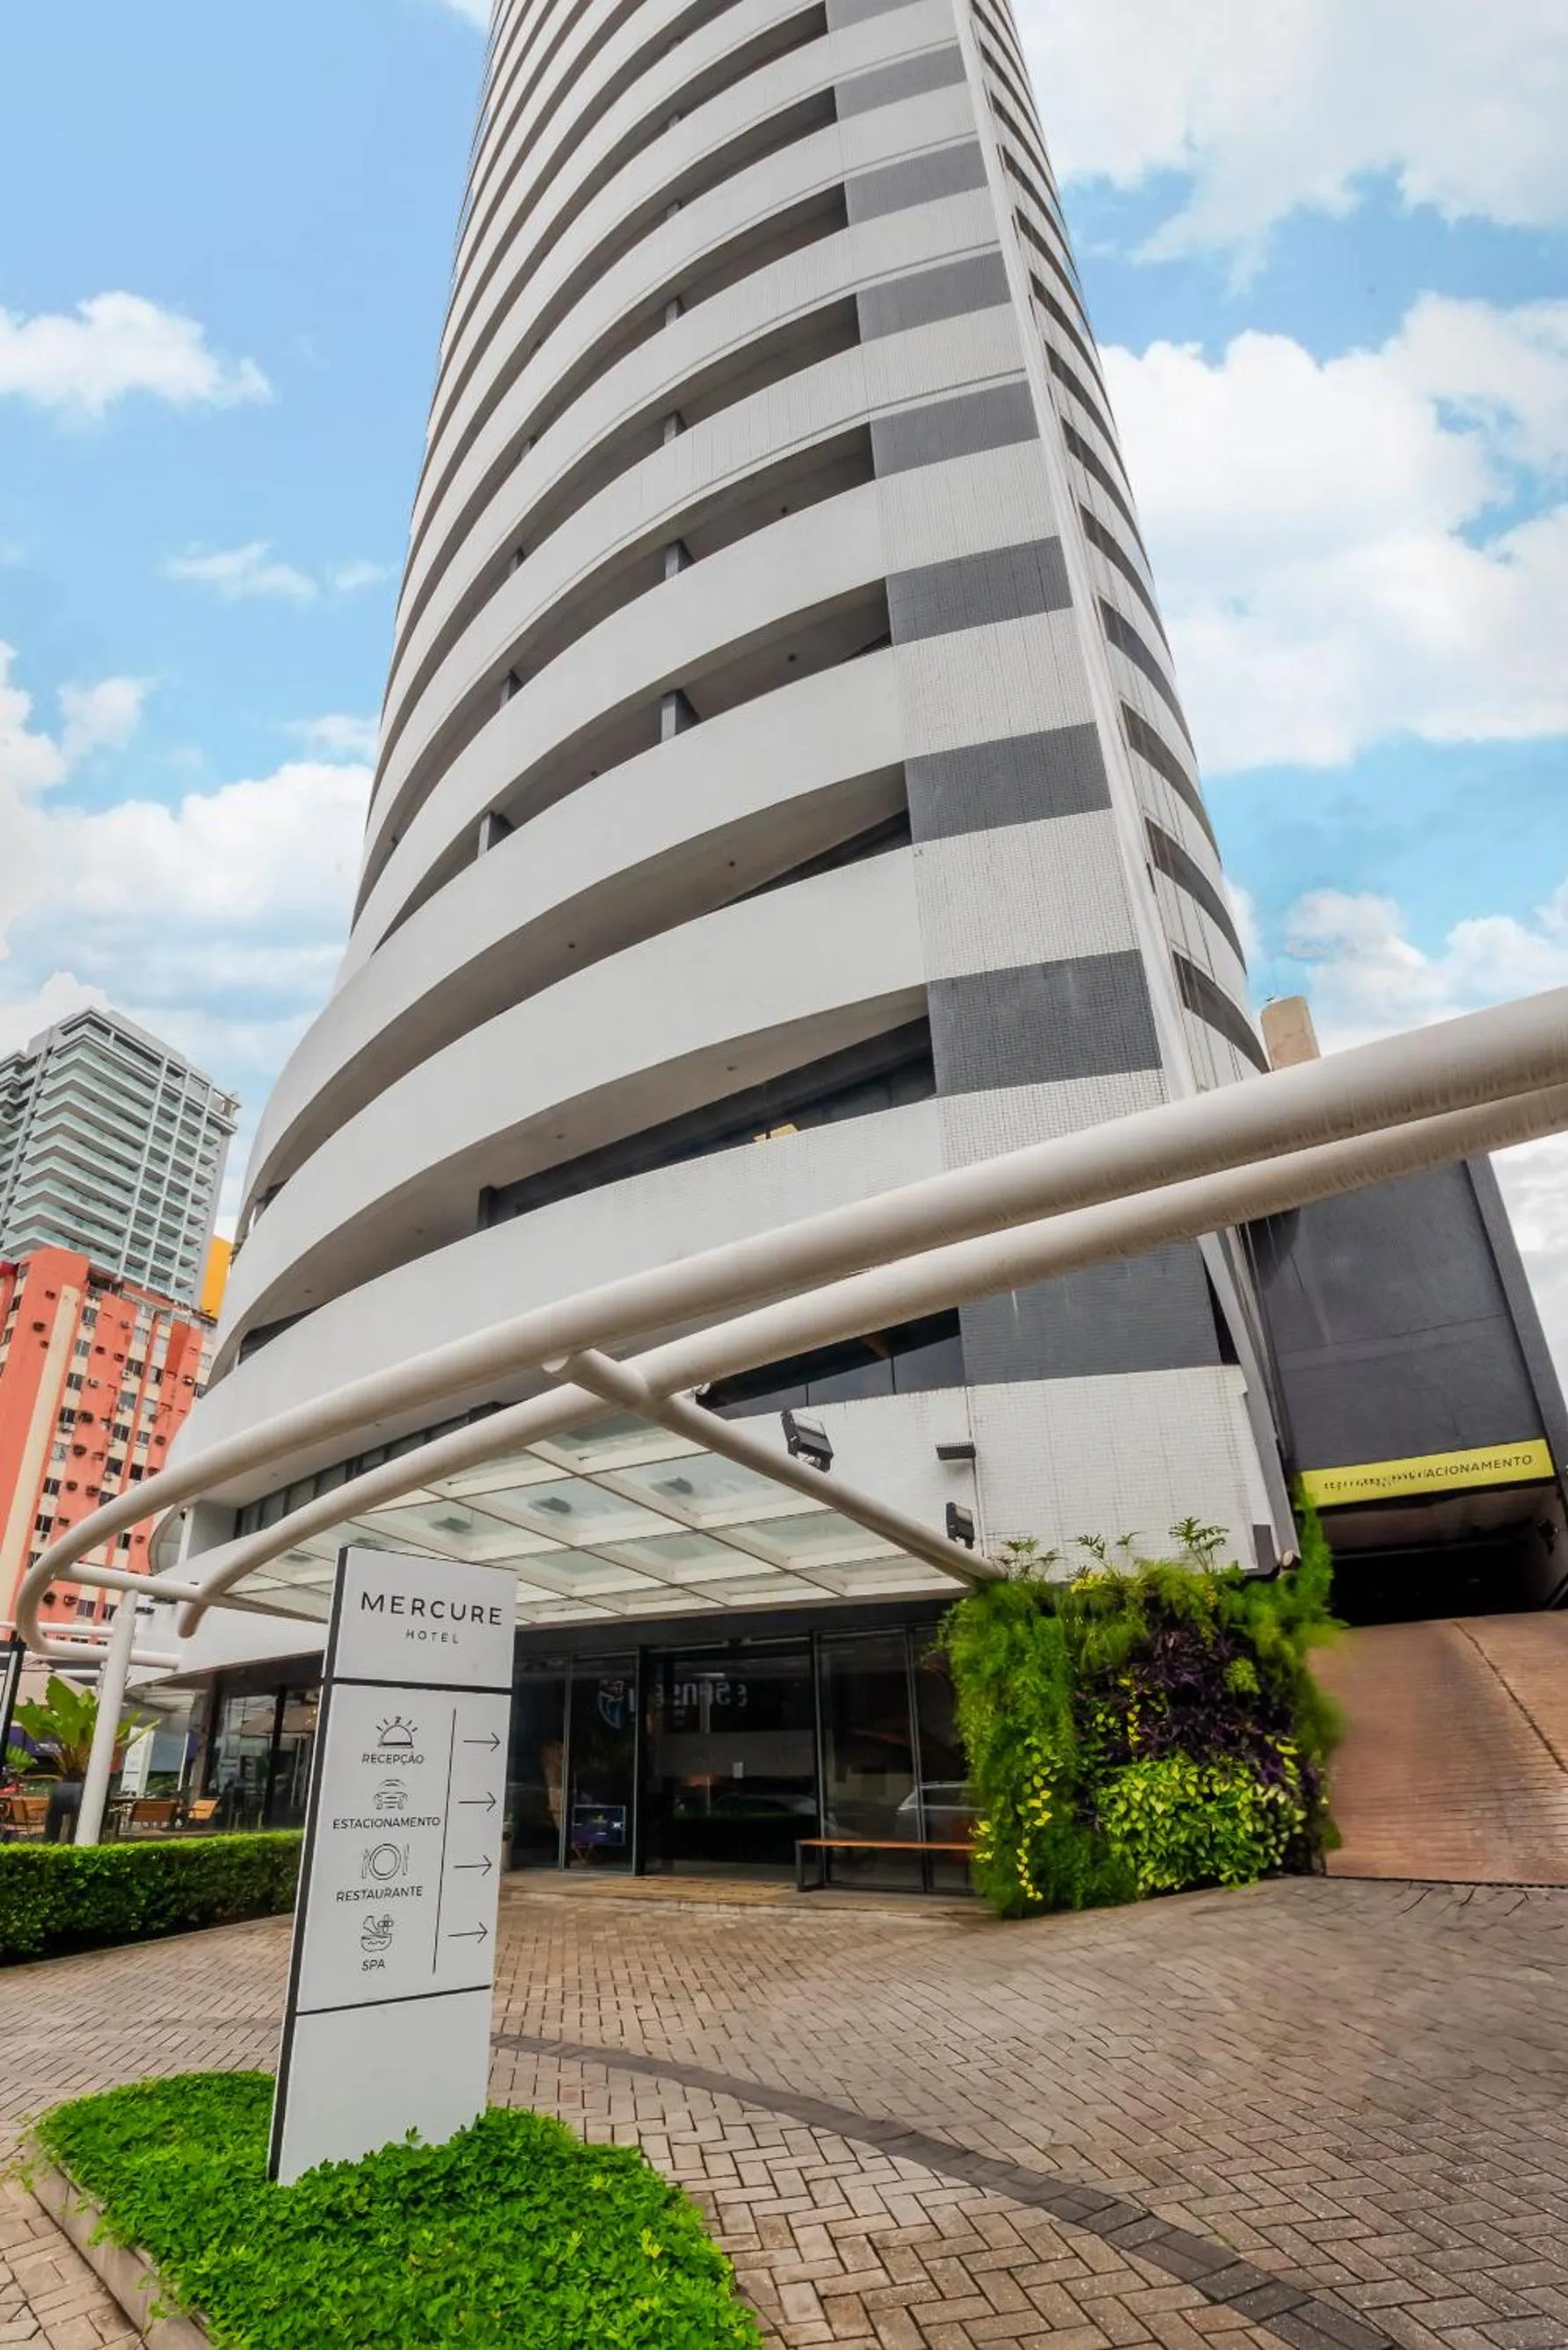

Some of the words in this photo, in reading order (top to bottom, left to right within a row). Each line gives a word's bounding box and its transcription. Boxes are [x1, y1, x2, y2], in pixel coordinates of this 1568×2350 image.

[1403, 1454, 1533, 1479] ACIONAMENTO
[361, 1591, 502, 1625] MERCURE
[405, 1629, 460, 1645] HOTEL
[361, 1751, 426, 1766] RECEPÇÃO
[332, 1816, 441, 1830] ESTACIONAMENTO
[336, 1885, 423, 1902] RESTAURANTE
[361, 1959, 387, 1972] SPA
